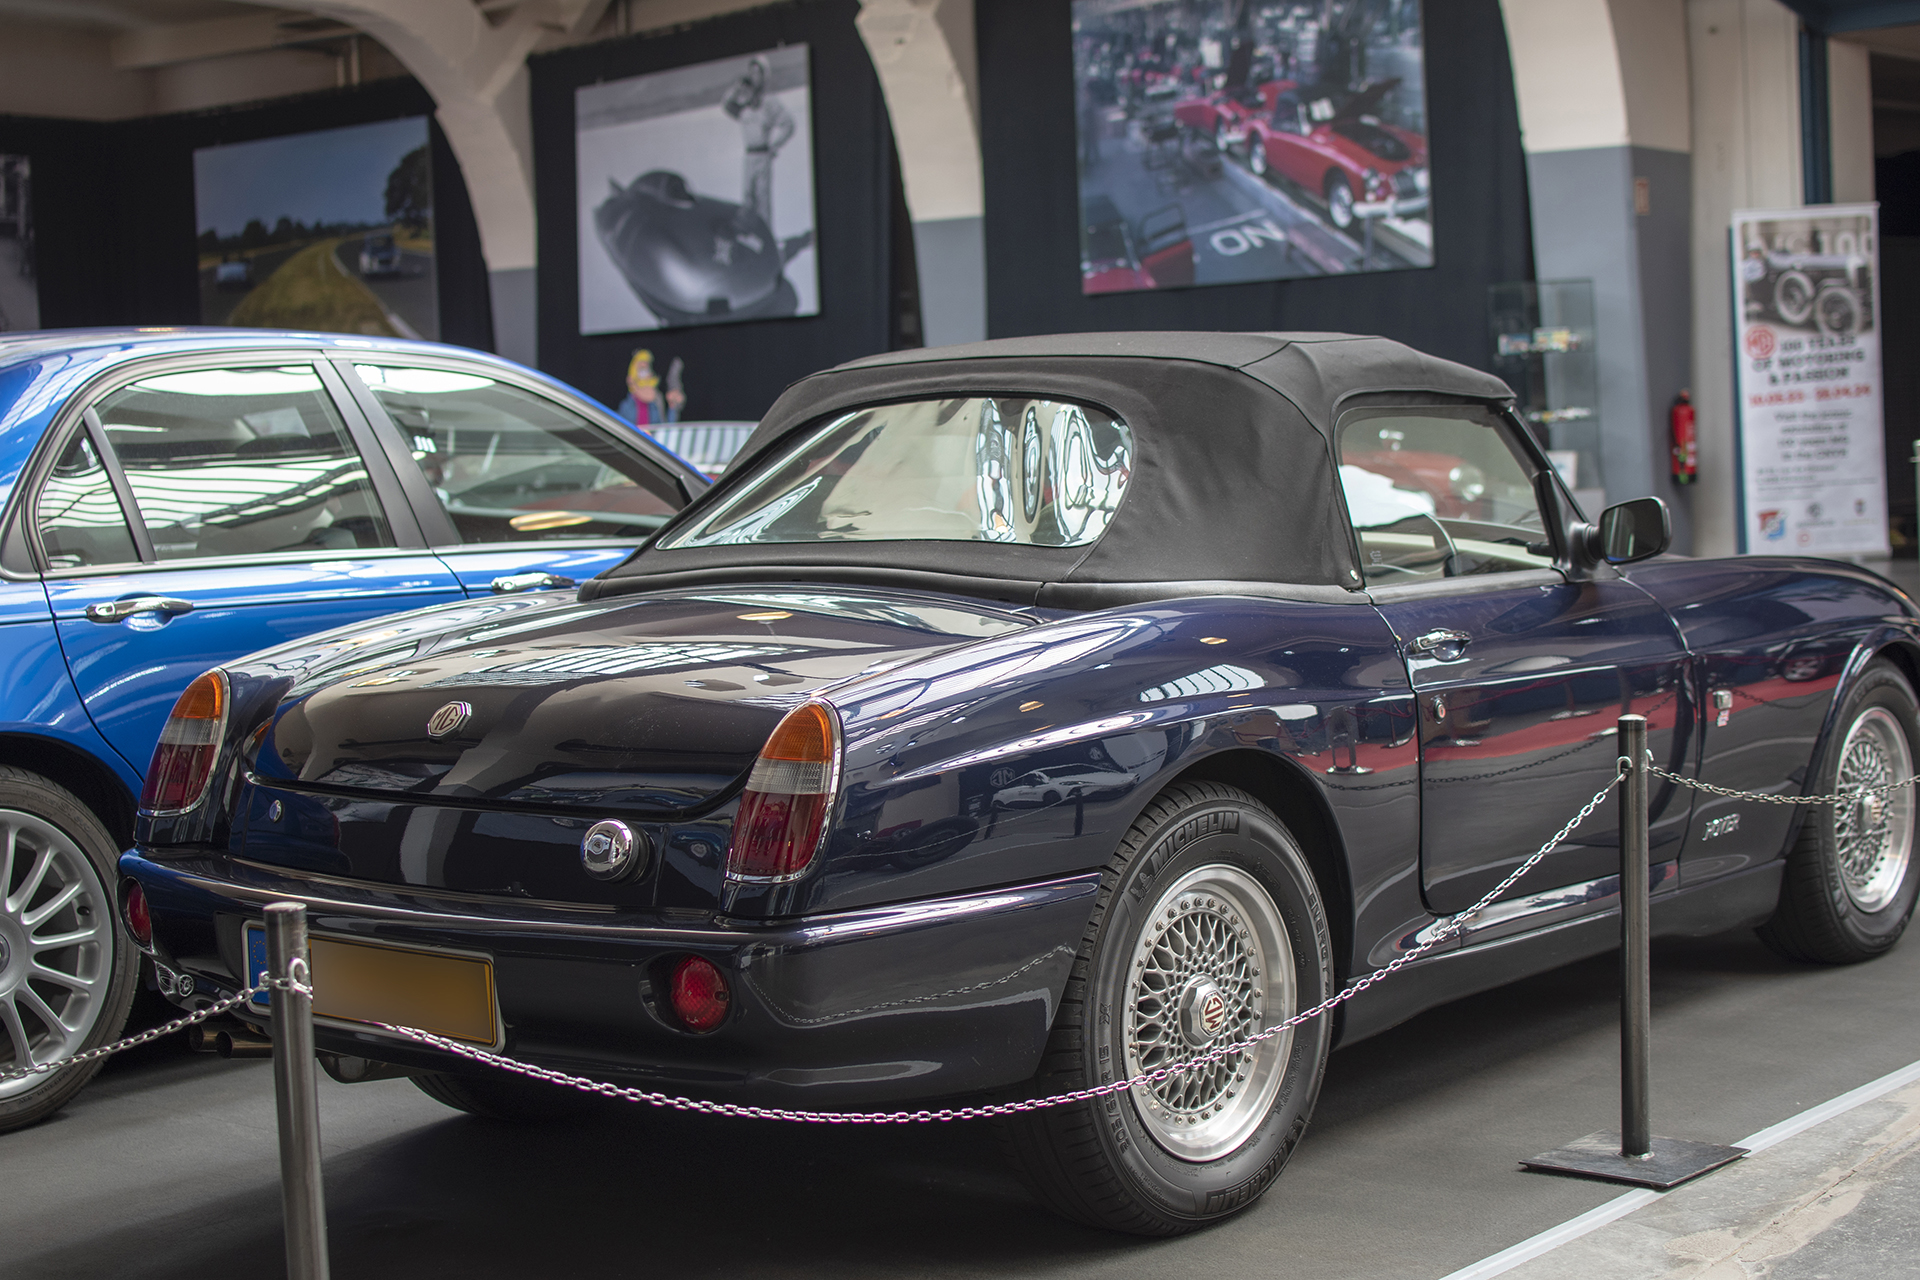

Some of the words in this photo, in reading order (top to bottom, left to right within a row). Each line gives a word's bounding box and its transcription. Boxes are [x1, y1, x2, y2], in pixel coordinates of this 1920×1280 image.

[432, 705, 459, 731] MG
[1151, 811, 1240, 874] MICHELIN
[1308, 891, 1330, 975] ENERGY
[1204, 997, 1224, 1030] MG
[1206, 1142, 1289, 1214] MICHELIN
